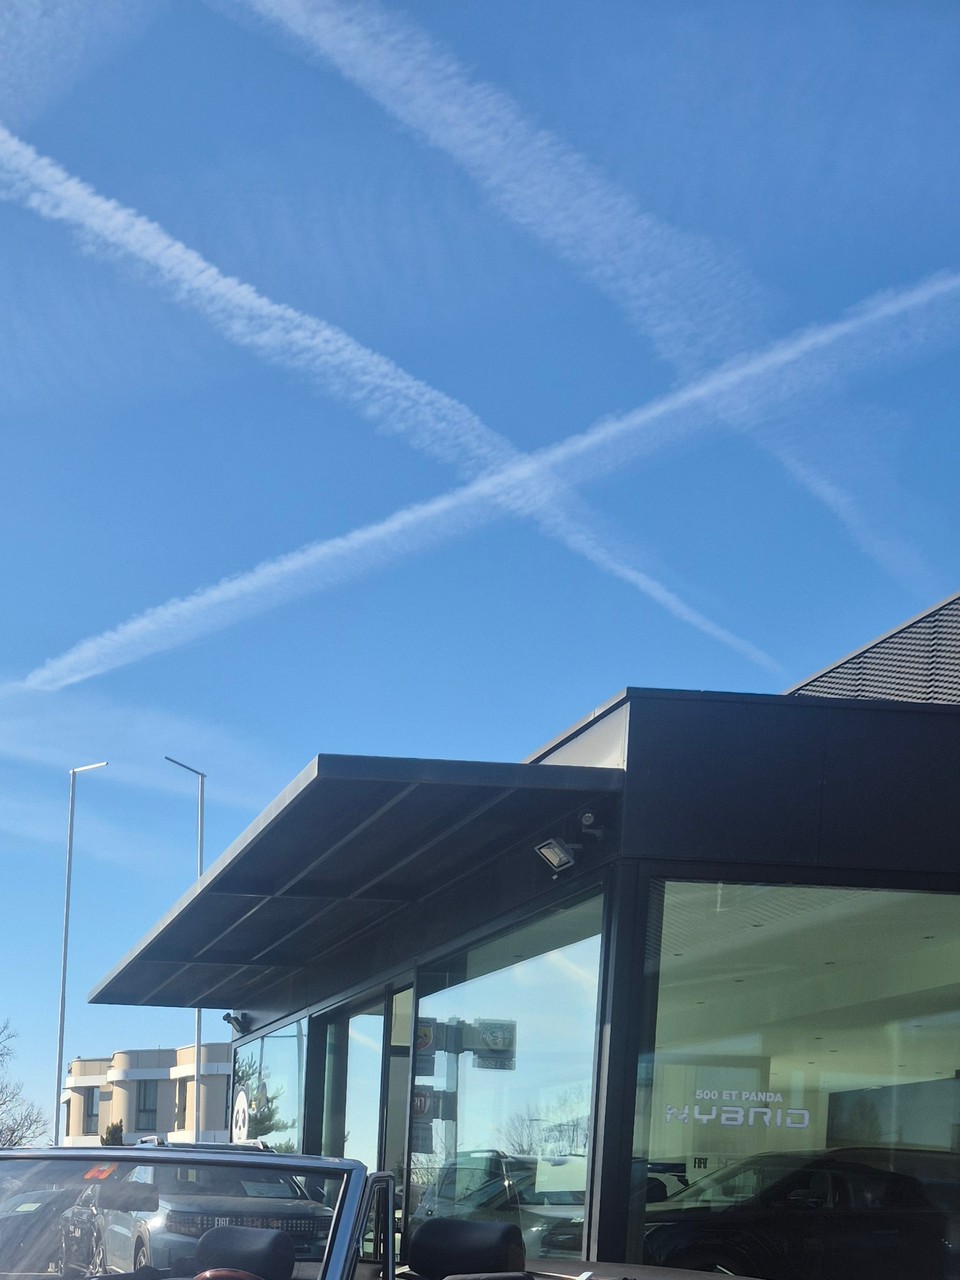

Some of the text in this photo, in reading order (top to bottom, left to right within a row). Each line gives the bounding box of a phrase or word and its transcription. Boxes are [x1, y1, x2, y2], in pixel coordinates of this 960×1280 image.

[695, 1090, 783, 1103] 500 ET PANDA
[693, 1157, 709, 1169] FIAT
[214, 1217, 230, 1227] FIAT
